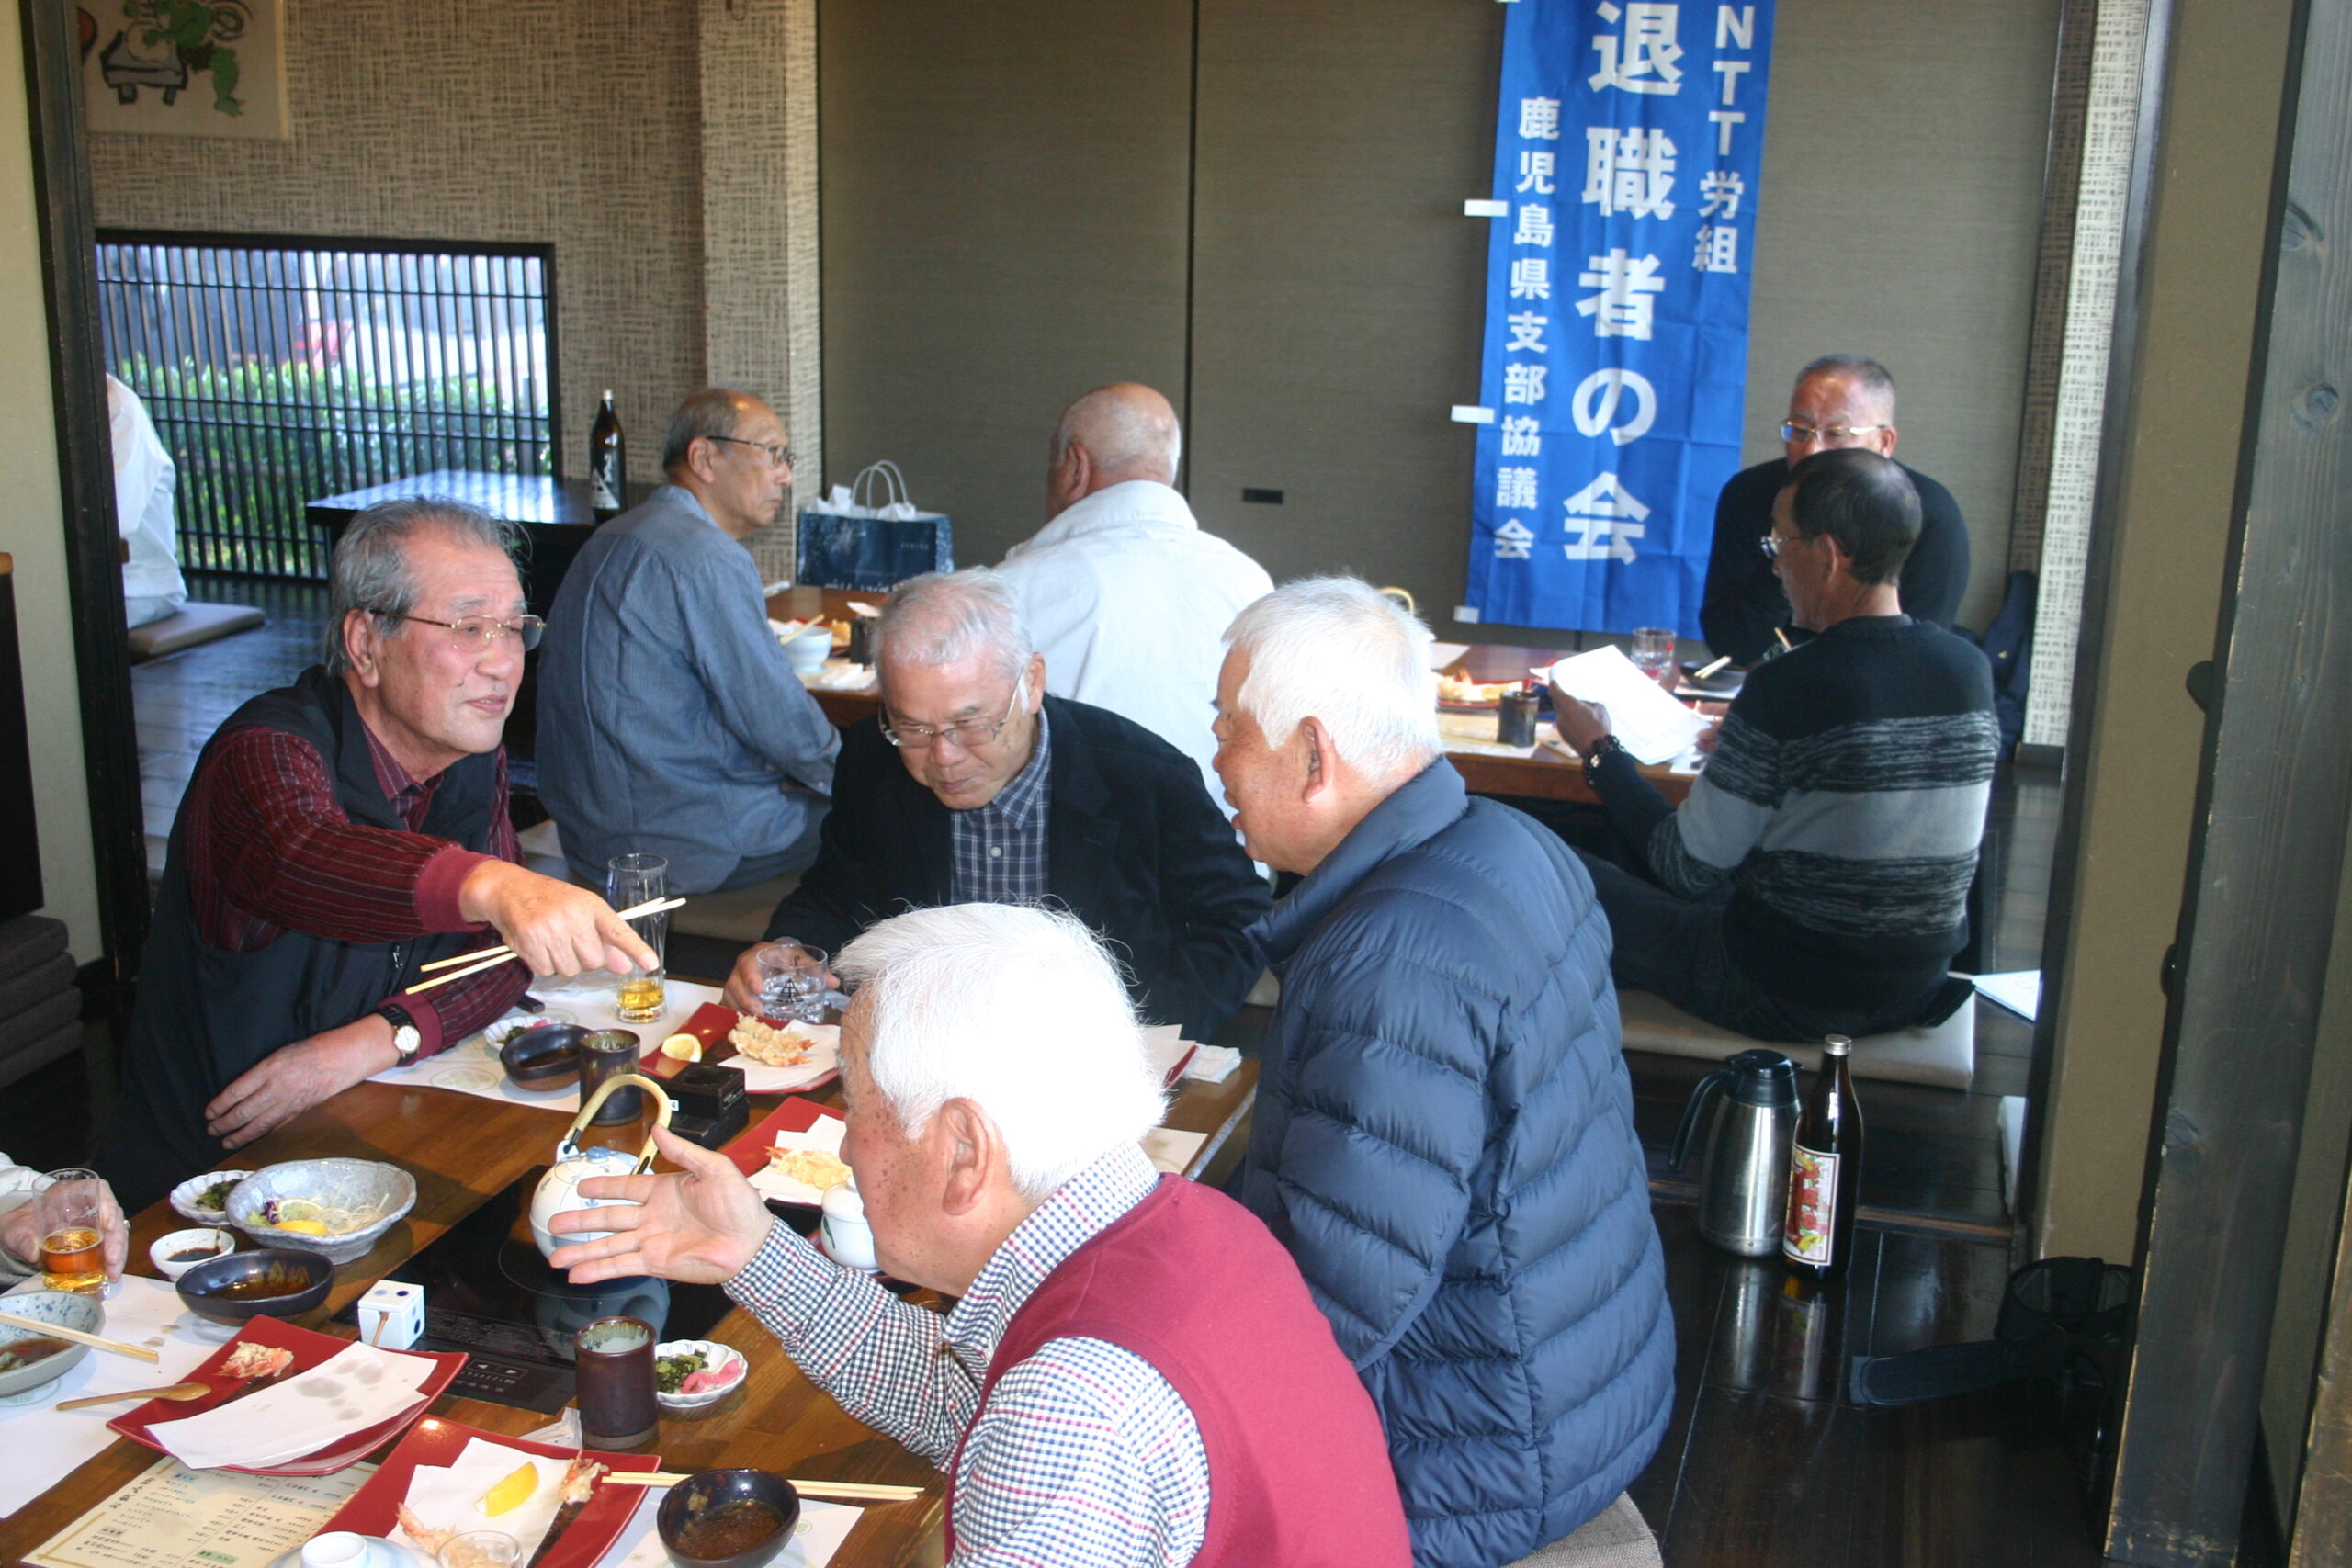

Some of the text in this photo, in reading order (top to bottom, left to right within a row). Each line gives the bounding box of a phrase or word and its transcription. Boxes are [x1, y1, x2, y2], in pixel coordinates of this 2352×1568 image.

[1493, 96, 1561, 559] 鹿児島県支部協議会
[1562, 1, 1684, 565] 退職者の会
[1691, 5, 1755, 274] NTT労組
